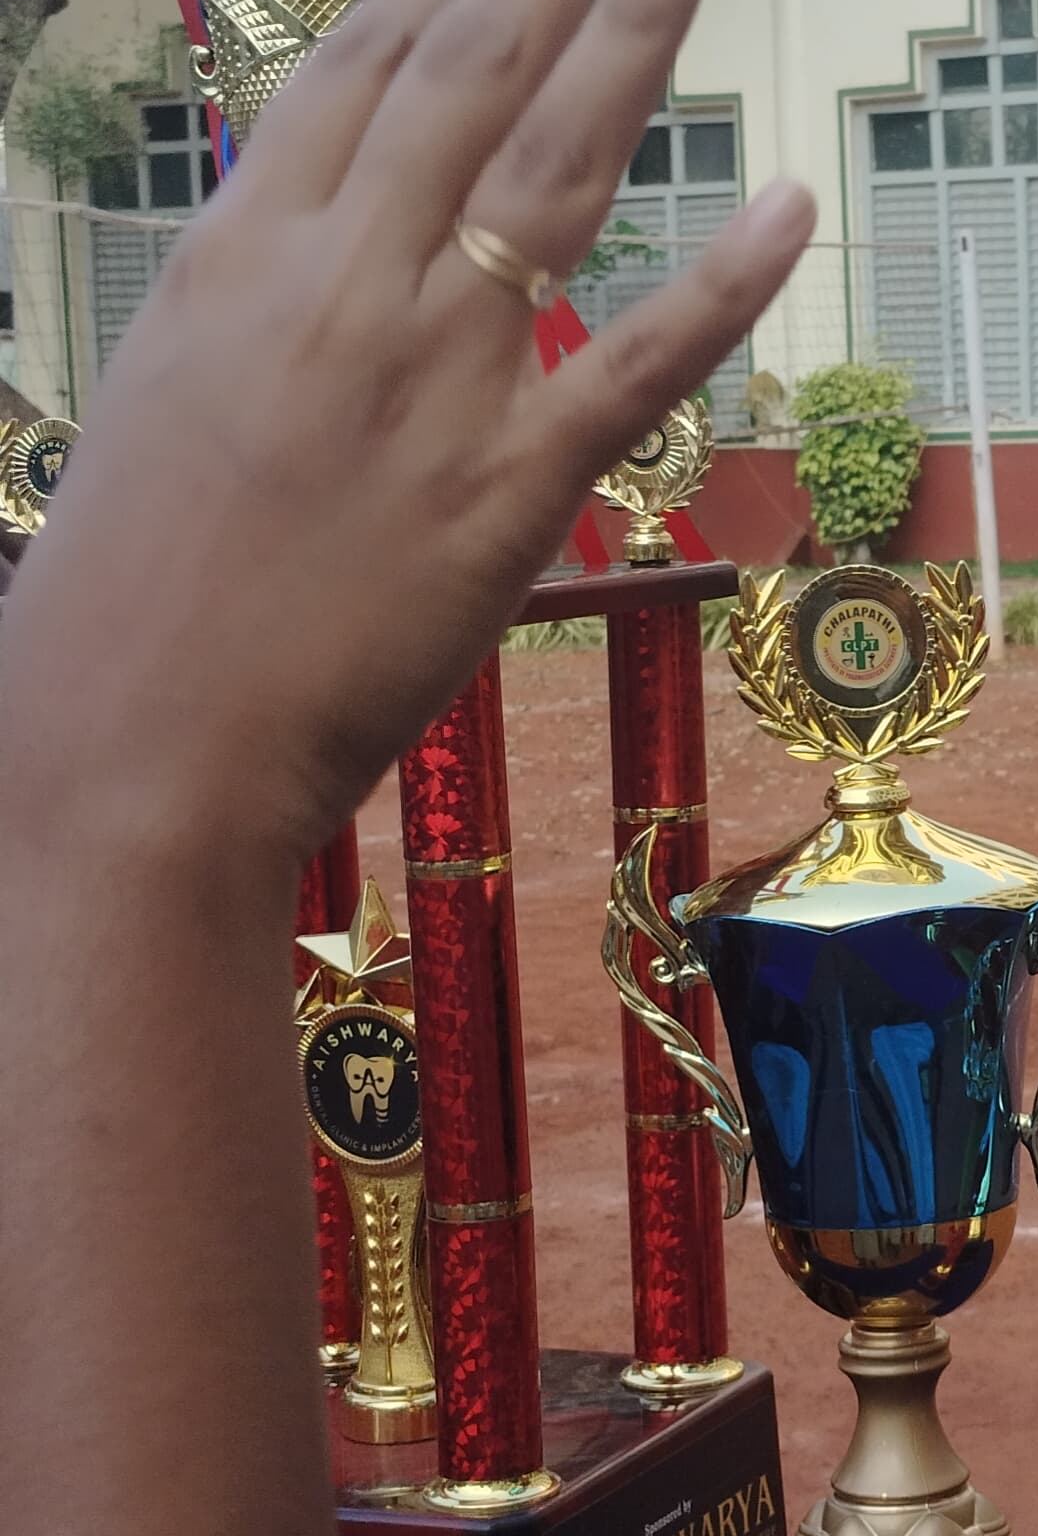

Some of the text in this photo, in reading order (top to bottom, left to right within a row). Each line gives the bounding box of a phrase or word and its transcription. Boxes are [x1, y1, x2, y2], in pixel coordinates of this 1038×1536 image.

[824, 607, 895, 637] CHALAPATHI
[844, 640, 876, 651] CLPT
[682, 1498, 692, 1513] by
